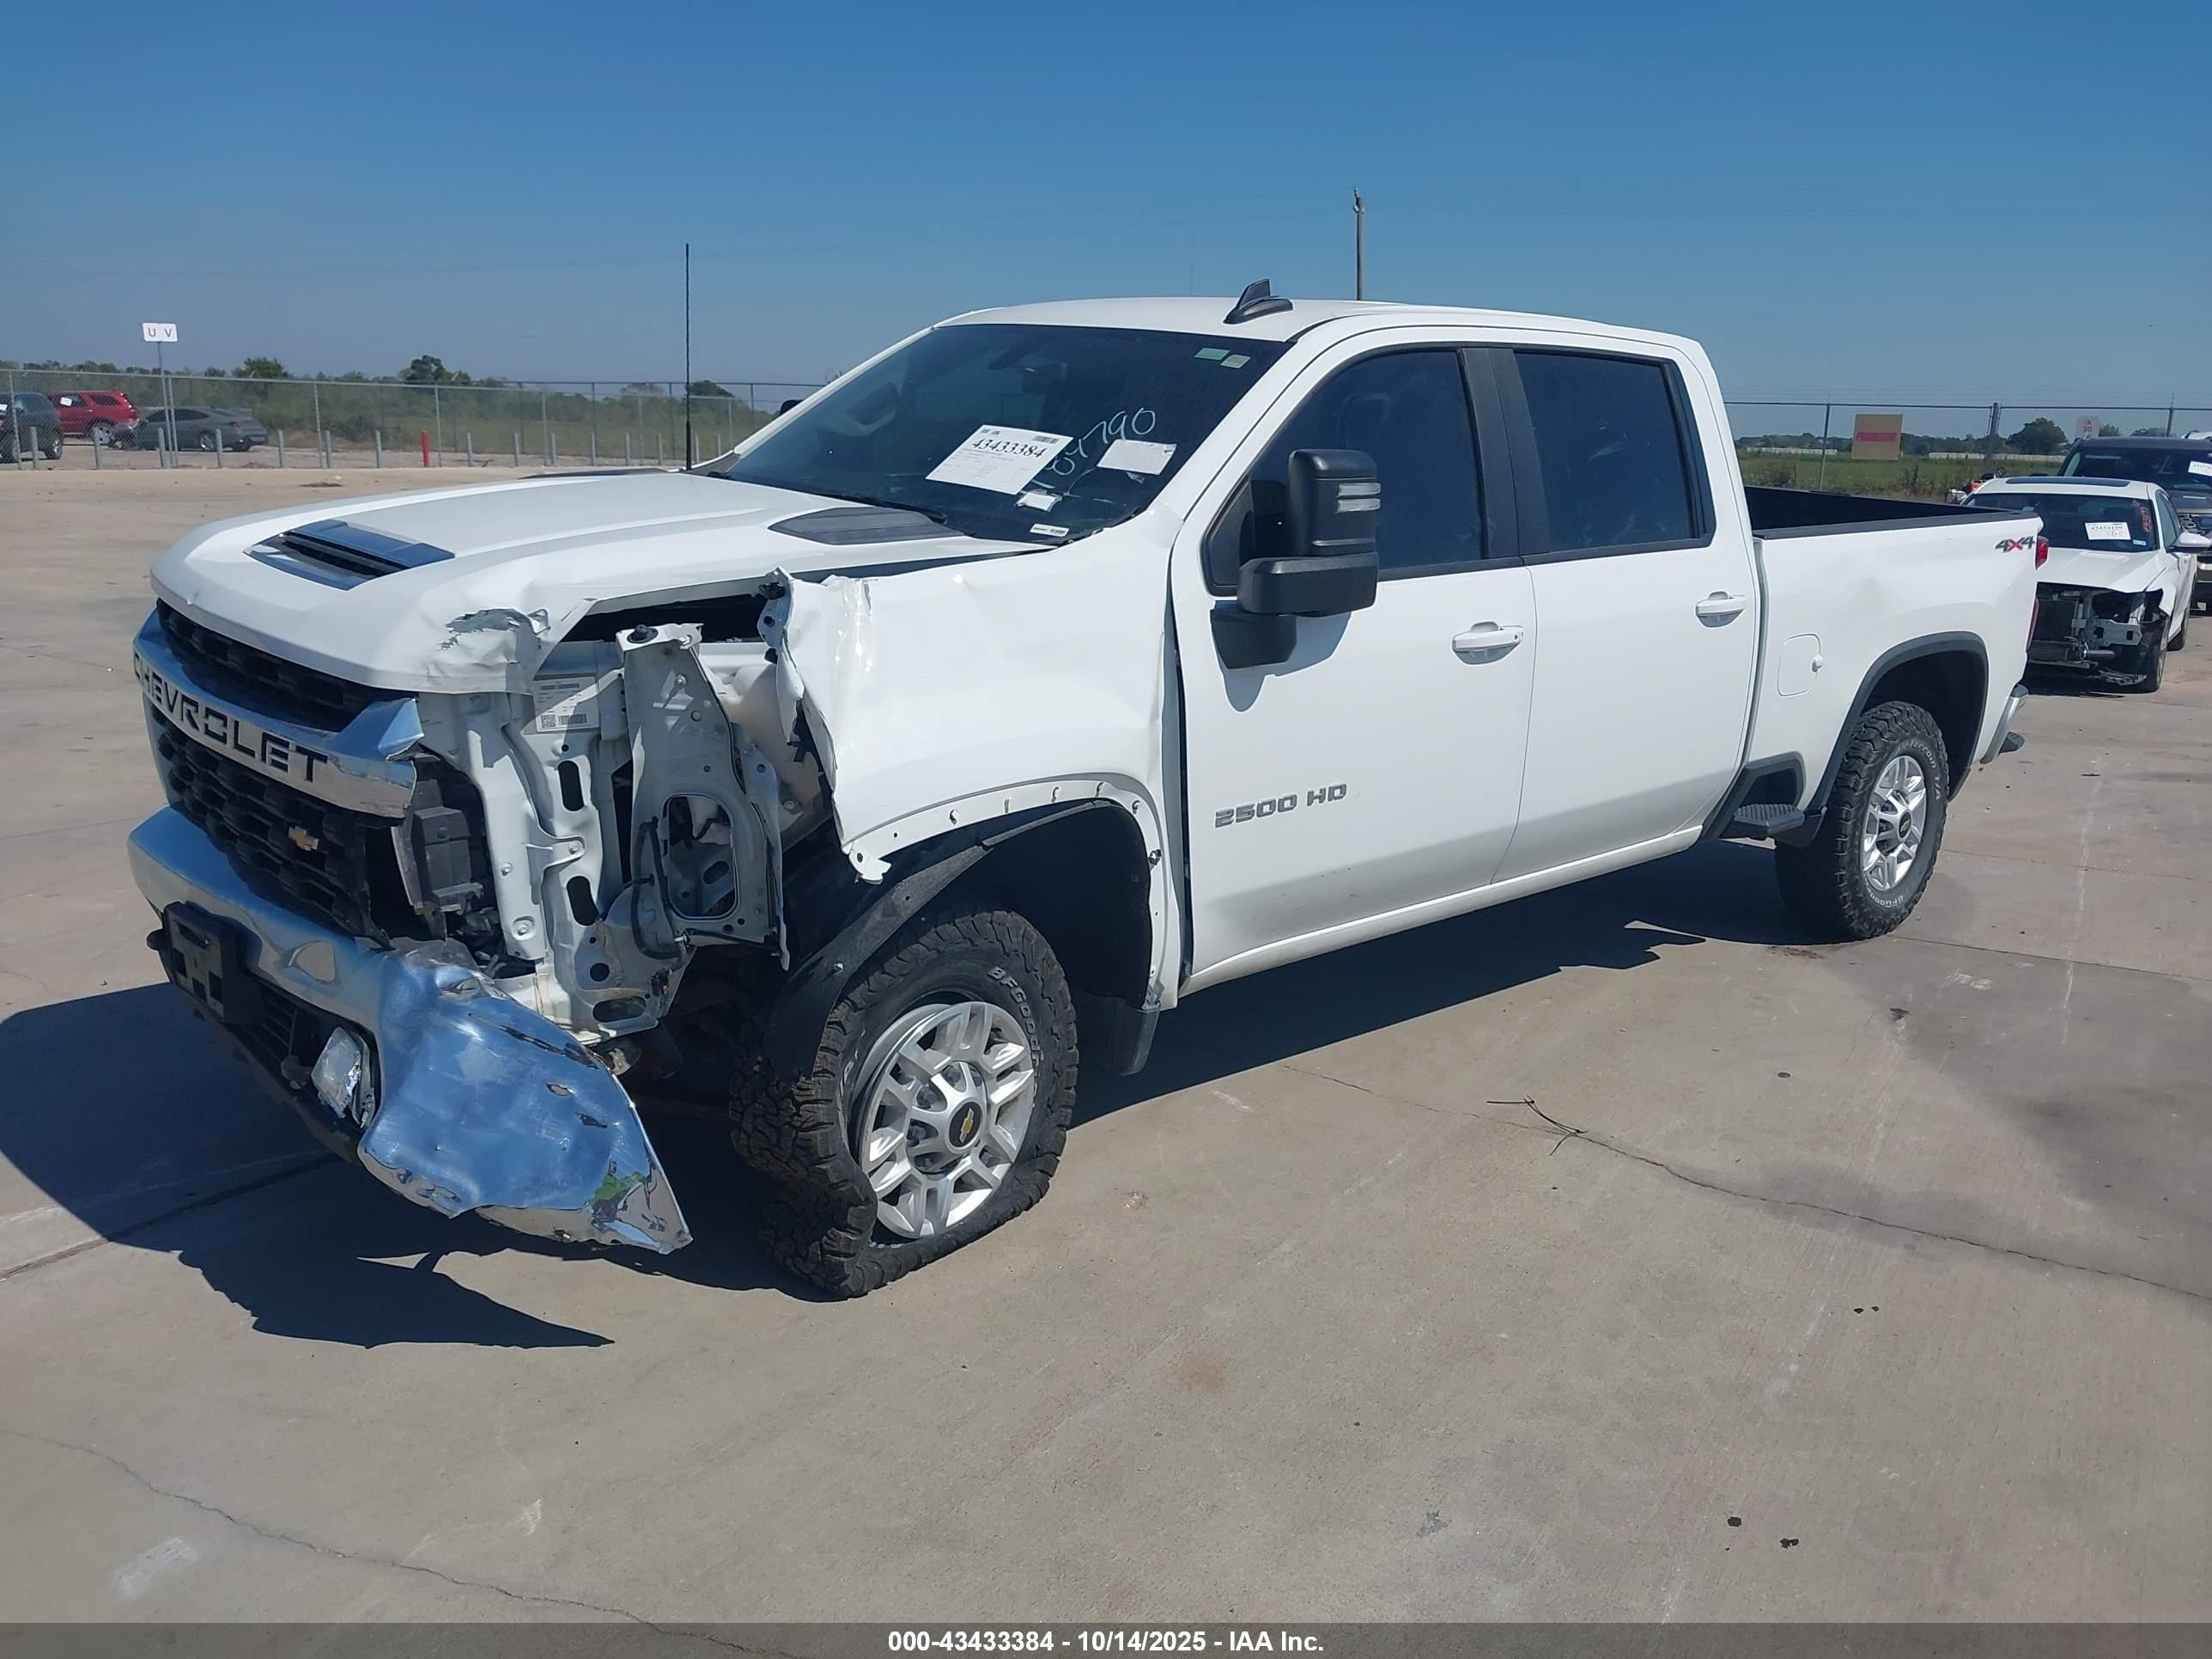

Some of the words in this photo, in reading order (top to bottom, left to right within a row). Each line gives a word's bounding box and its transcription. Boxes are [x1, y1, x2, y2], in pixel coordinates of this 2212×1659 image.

[148, 328, 156, 337] U
[164, 328, 173, 337] V
[971, 437, 1048, 459] 43433384
[133, 653, 329, 783] CHEVROLET
[1215, 793, 1298, 829] 2500
[1306, 782, 1347, 807] HD
